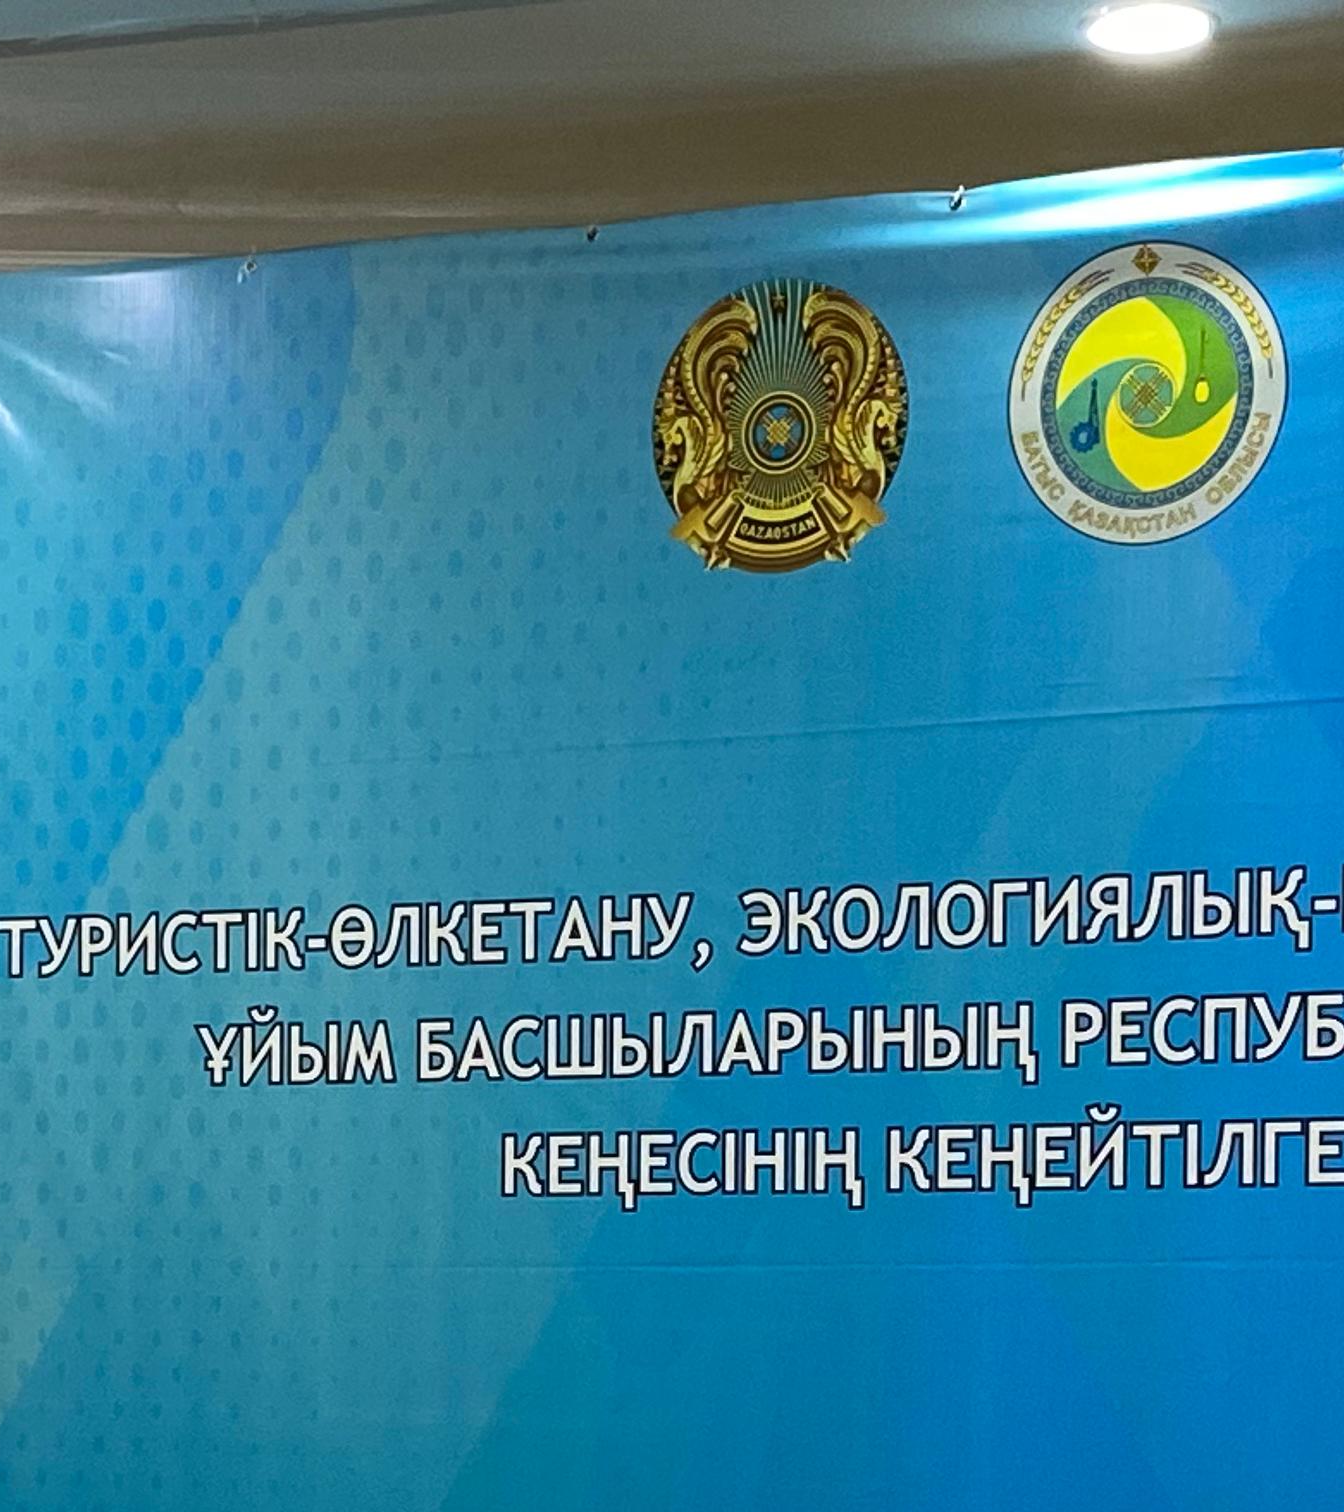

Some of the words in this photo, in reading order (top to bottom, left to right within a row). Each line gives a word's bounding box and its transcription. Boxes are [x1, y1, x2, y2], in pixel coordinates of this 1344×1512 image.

[1020, 431, 1066, 502] БАТЫС
[196, 1006, 396, 1086] ҰЙЫМ
[418, 1003, 1038, 1084] БАСШЫЛАРЫНЫҢ
[502, 1128, 864, 1211] КЕҢЕСІНІҢ
